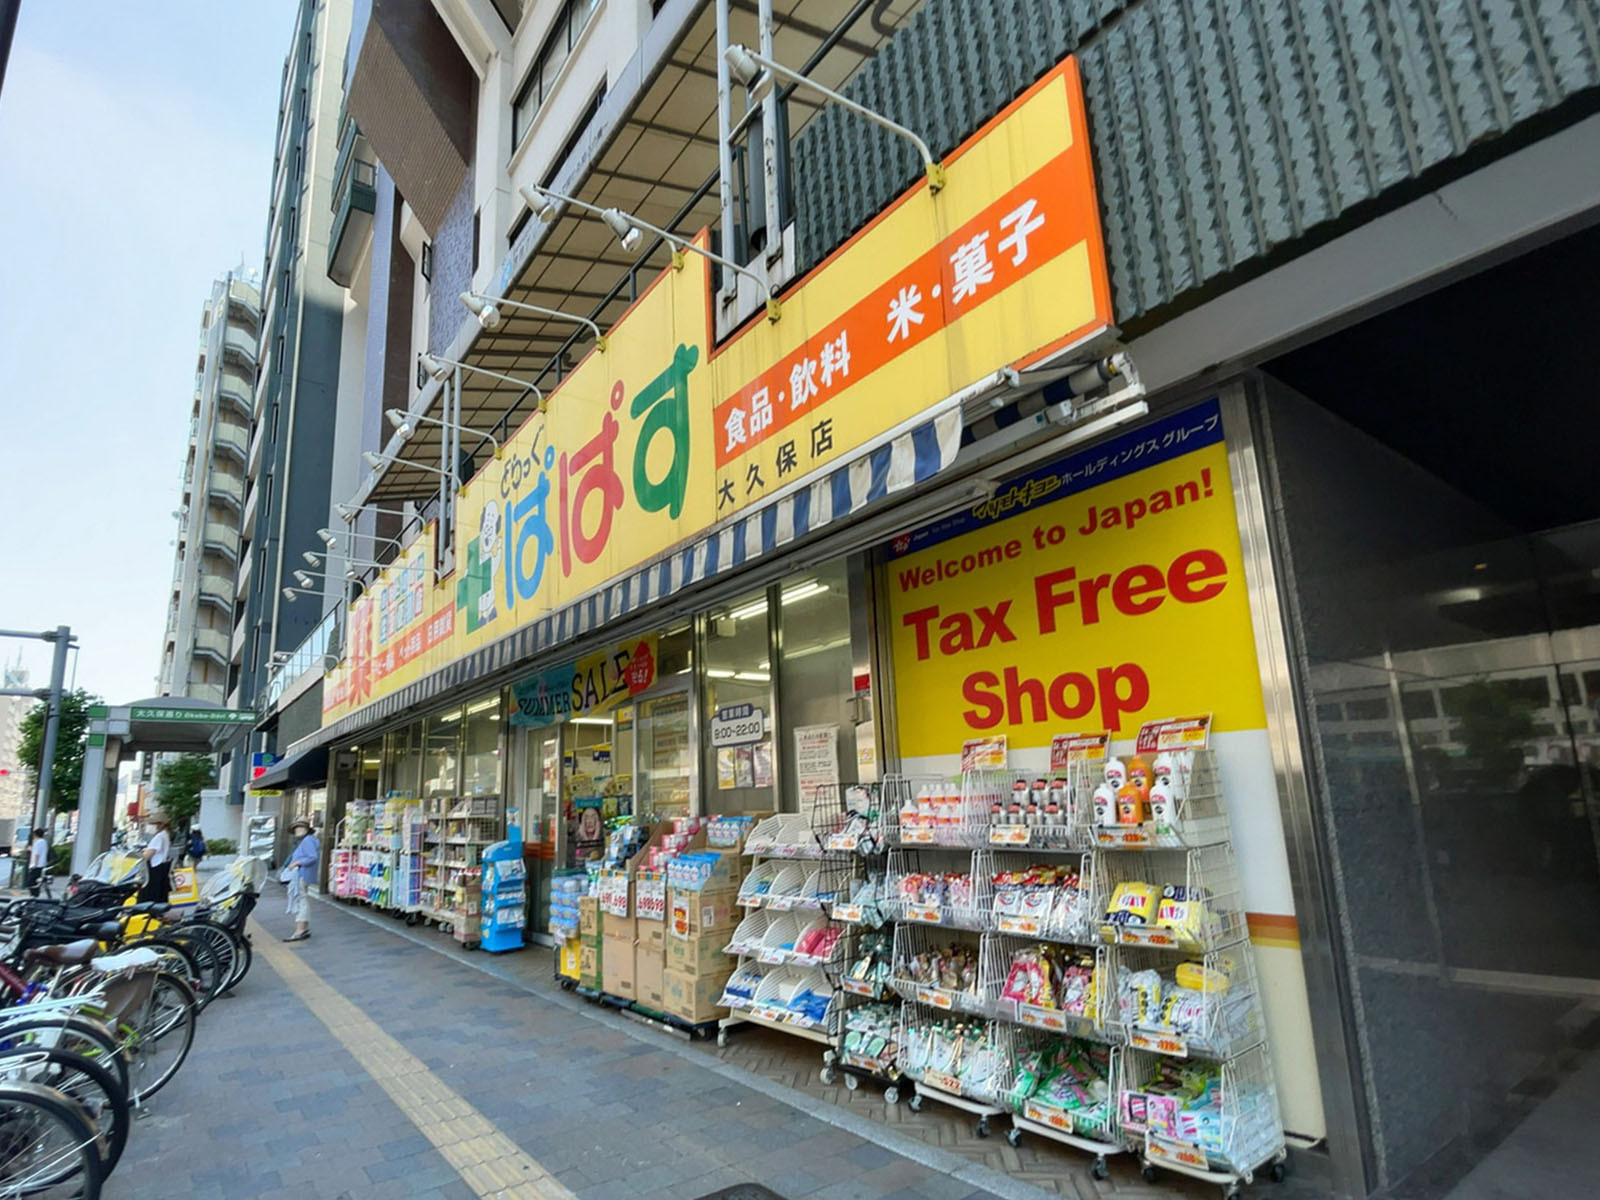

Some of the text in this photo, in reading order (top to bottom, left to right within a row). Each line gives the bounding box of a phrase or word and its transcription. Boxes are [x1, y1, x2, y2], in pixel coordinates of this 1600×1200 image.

[724, 198, 1045, 453] 食品・飲料 米・菓子
[504, 343, 699, 610] ぱぱす
[718, 418, 833, 510] 大久保店
[899, 468, 1214, 592] Welcome to Japan!
[903, 549, 1228, 661] Tax Free
[571, 650, 630, 712] SALE
[962, 663, 1149, 731] Shop
